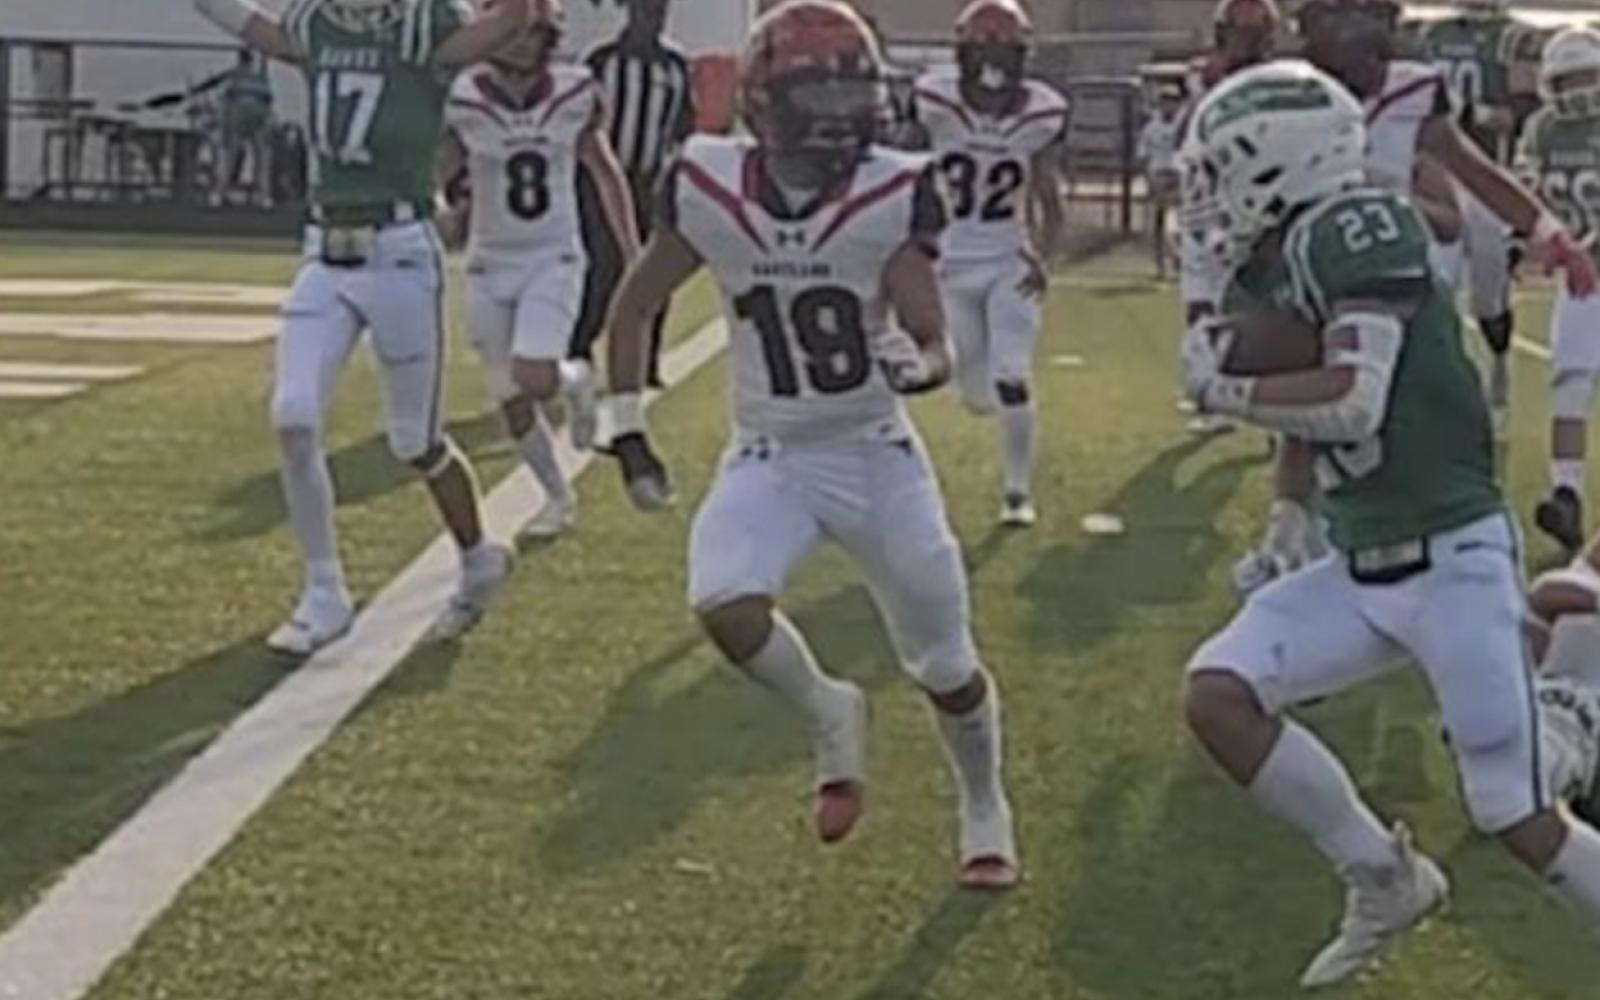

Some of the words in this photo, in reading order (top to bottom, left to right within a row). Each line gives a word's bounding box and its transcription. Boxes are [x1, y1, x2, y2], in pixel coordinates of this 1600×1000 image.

[315, 69, 385, 165] 17
[506, 151, 549, 222] 8
[941, 153, 1023, 222] 32
[1336, 202, 1399, 252] 23
